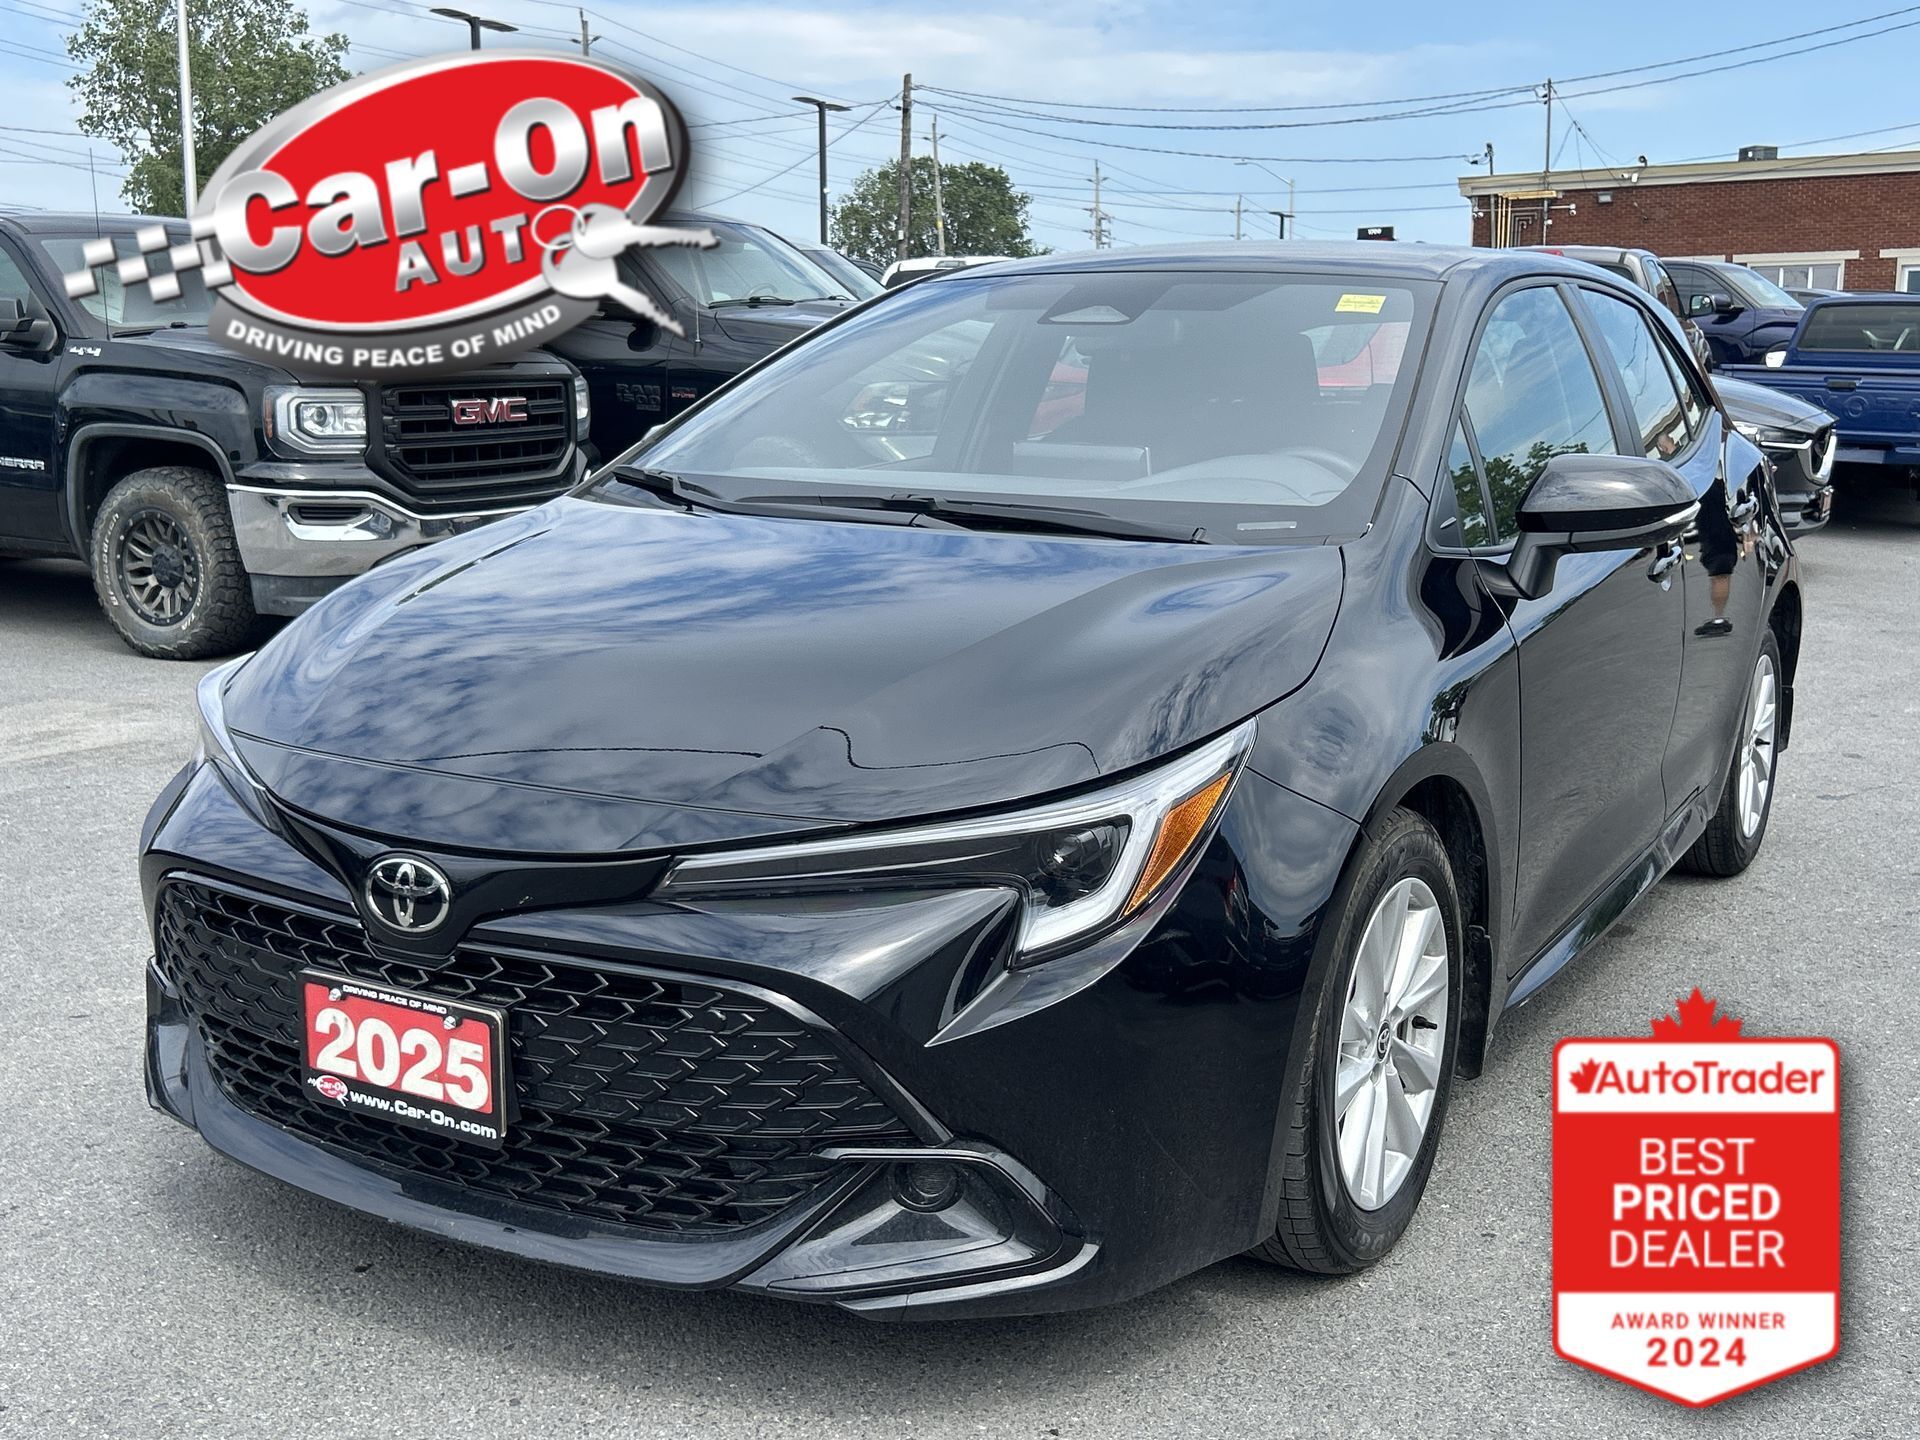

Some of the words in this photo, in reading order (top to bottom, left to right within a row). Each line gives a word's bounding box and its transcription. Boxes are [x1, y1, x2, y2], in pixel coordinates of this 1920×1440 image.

[451, 397, 527, 425] GMC
[0, 457, 45, 470] IERRA
[342, 984, 377, 998] DRIVING
[379, 992, 408, 1006] PEACE
[408, 1000, 422, 1008] OF
[423, 1002, 447, 1014] MIND
[315, 1007, 489, 1110] 2025
[350, 1091, 497, 1139] www.Car-On.com
